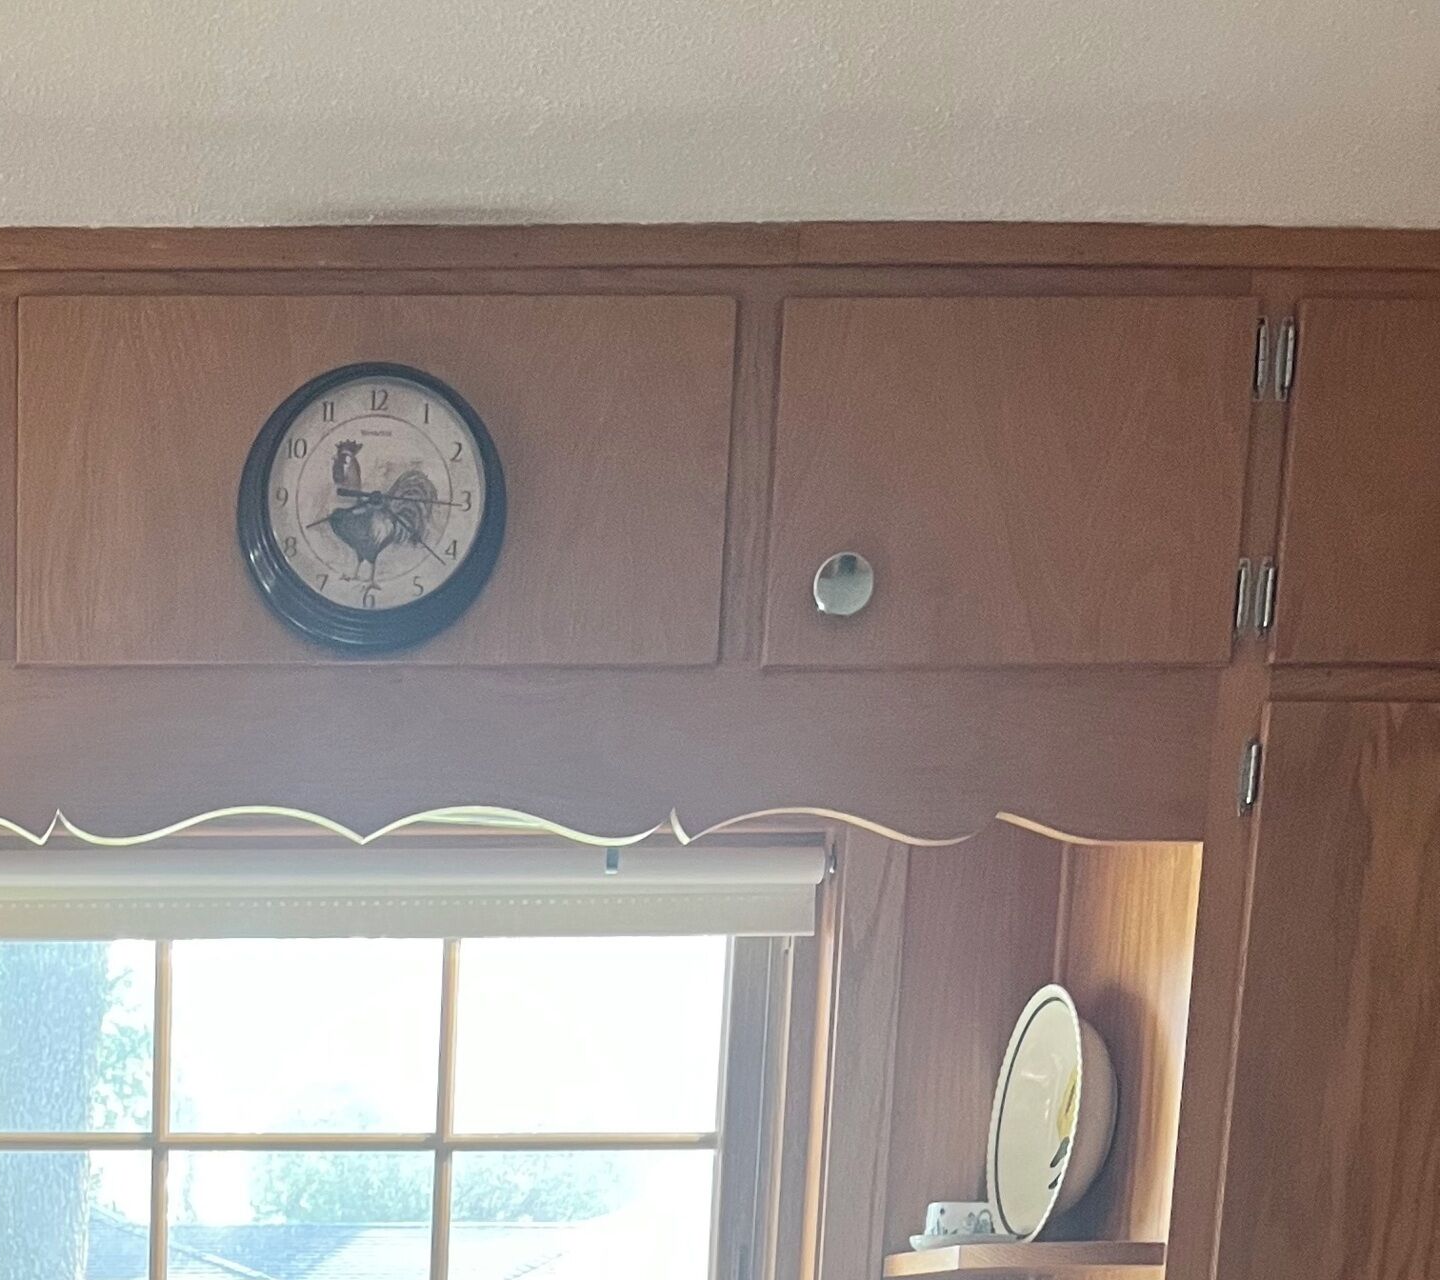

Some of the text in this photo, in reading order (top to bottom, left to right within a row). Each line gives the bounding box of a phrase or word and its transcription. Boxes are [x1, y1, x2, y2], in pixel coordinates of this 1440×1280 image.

[370, 389, 389, 411] 12
[322, 402, 335, 423] 11
[424, 403, 429, 424] 1
[287, 438, 307, 459] 10
[450, 443, 463, 463] 2
[276, 487, 288, 508] 9
[461, 491, 473, 512] 3
[284, 536, 296, 557] 8
[445, 540, 457, 560] 4
[316, 574, 329, 592] 7
[414, 575, 424, 596] 5
[362, 584, 379, 608] 6
